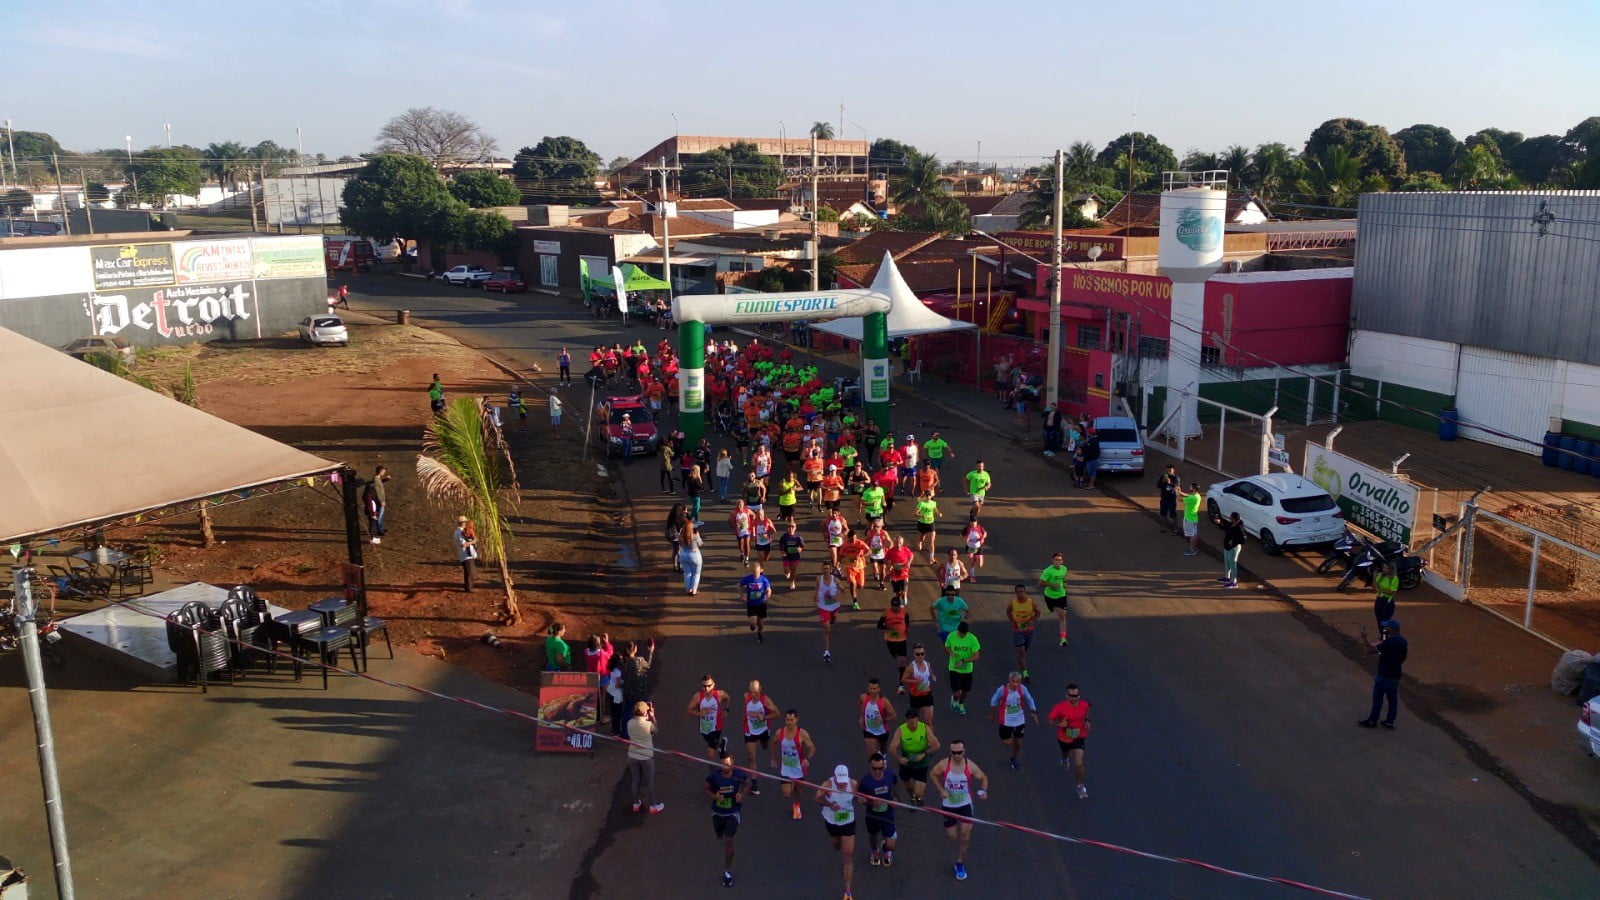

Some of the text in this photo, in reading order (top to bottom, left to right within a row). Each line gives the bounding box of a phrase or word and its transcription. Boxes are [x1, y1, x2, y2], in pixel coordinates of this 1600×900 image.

[202, 245, 220, 256] KM
[1000, 236, 1023, 246] CORPO
[1024, 238, 1034, 247] DE
[1035, 239, 1078, 250] BOMROS
[166, 288, 185, 298] Auto
[1094, 277, 1129, 295] SOMOS
[1131, 280, 1152, 297] POR
[93, 284, 250, 338] Detroit
[736, 297, 838, 314] FUNDESPORTE
[1348, 472, 1410, 514] Orvalho
[1360, 505, 1403, 534] 3565-6720
